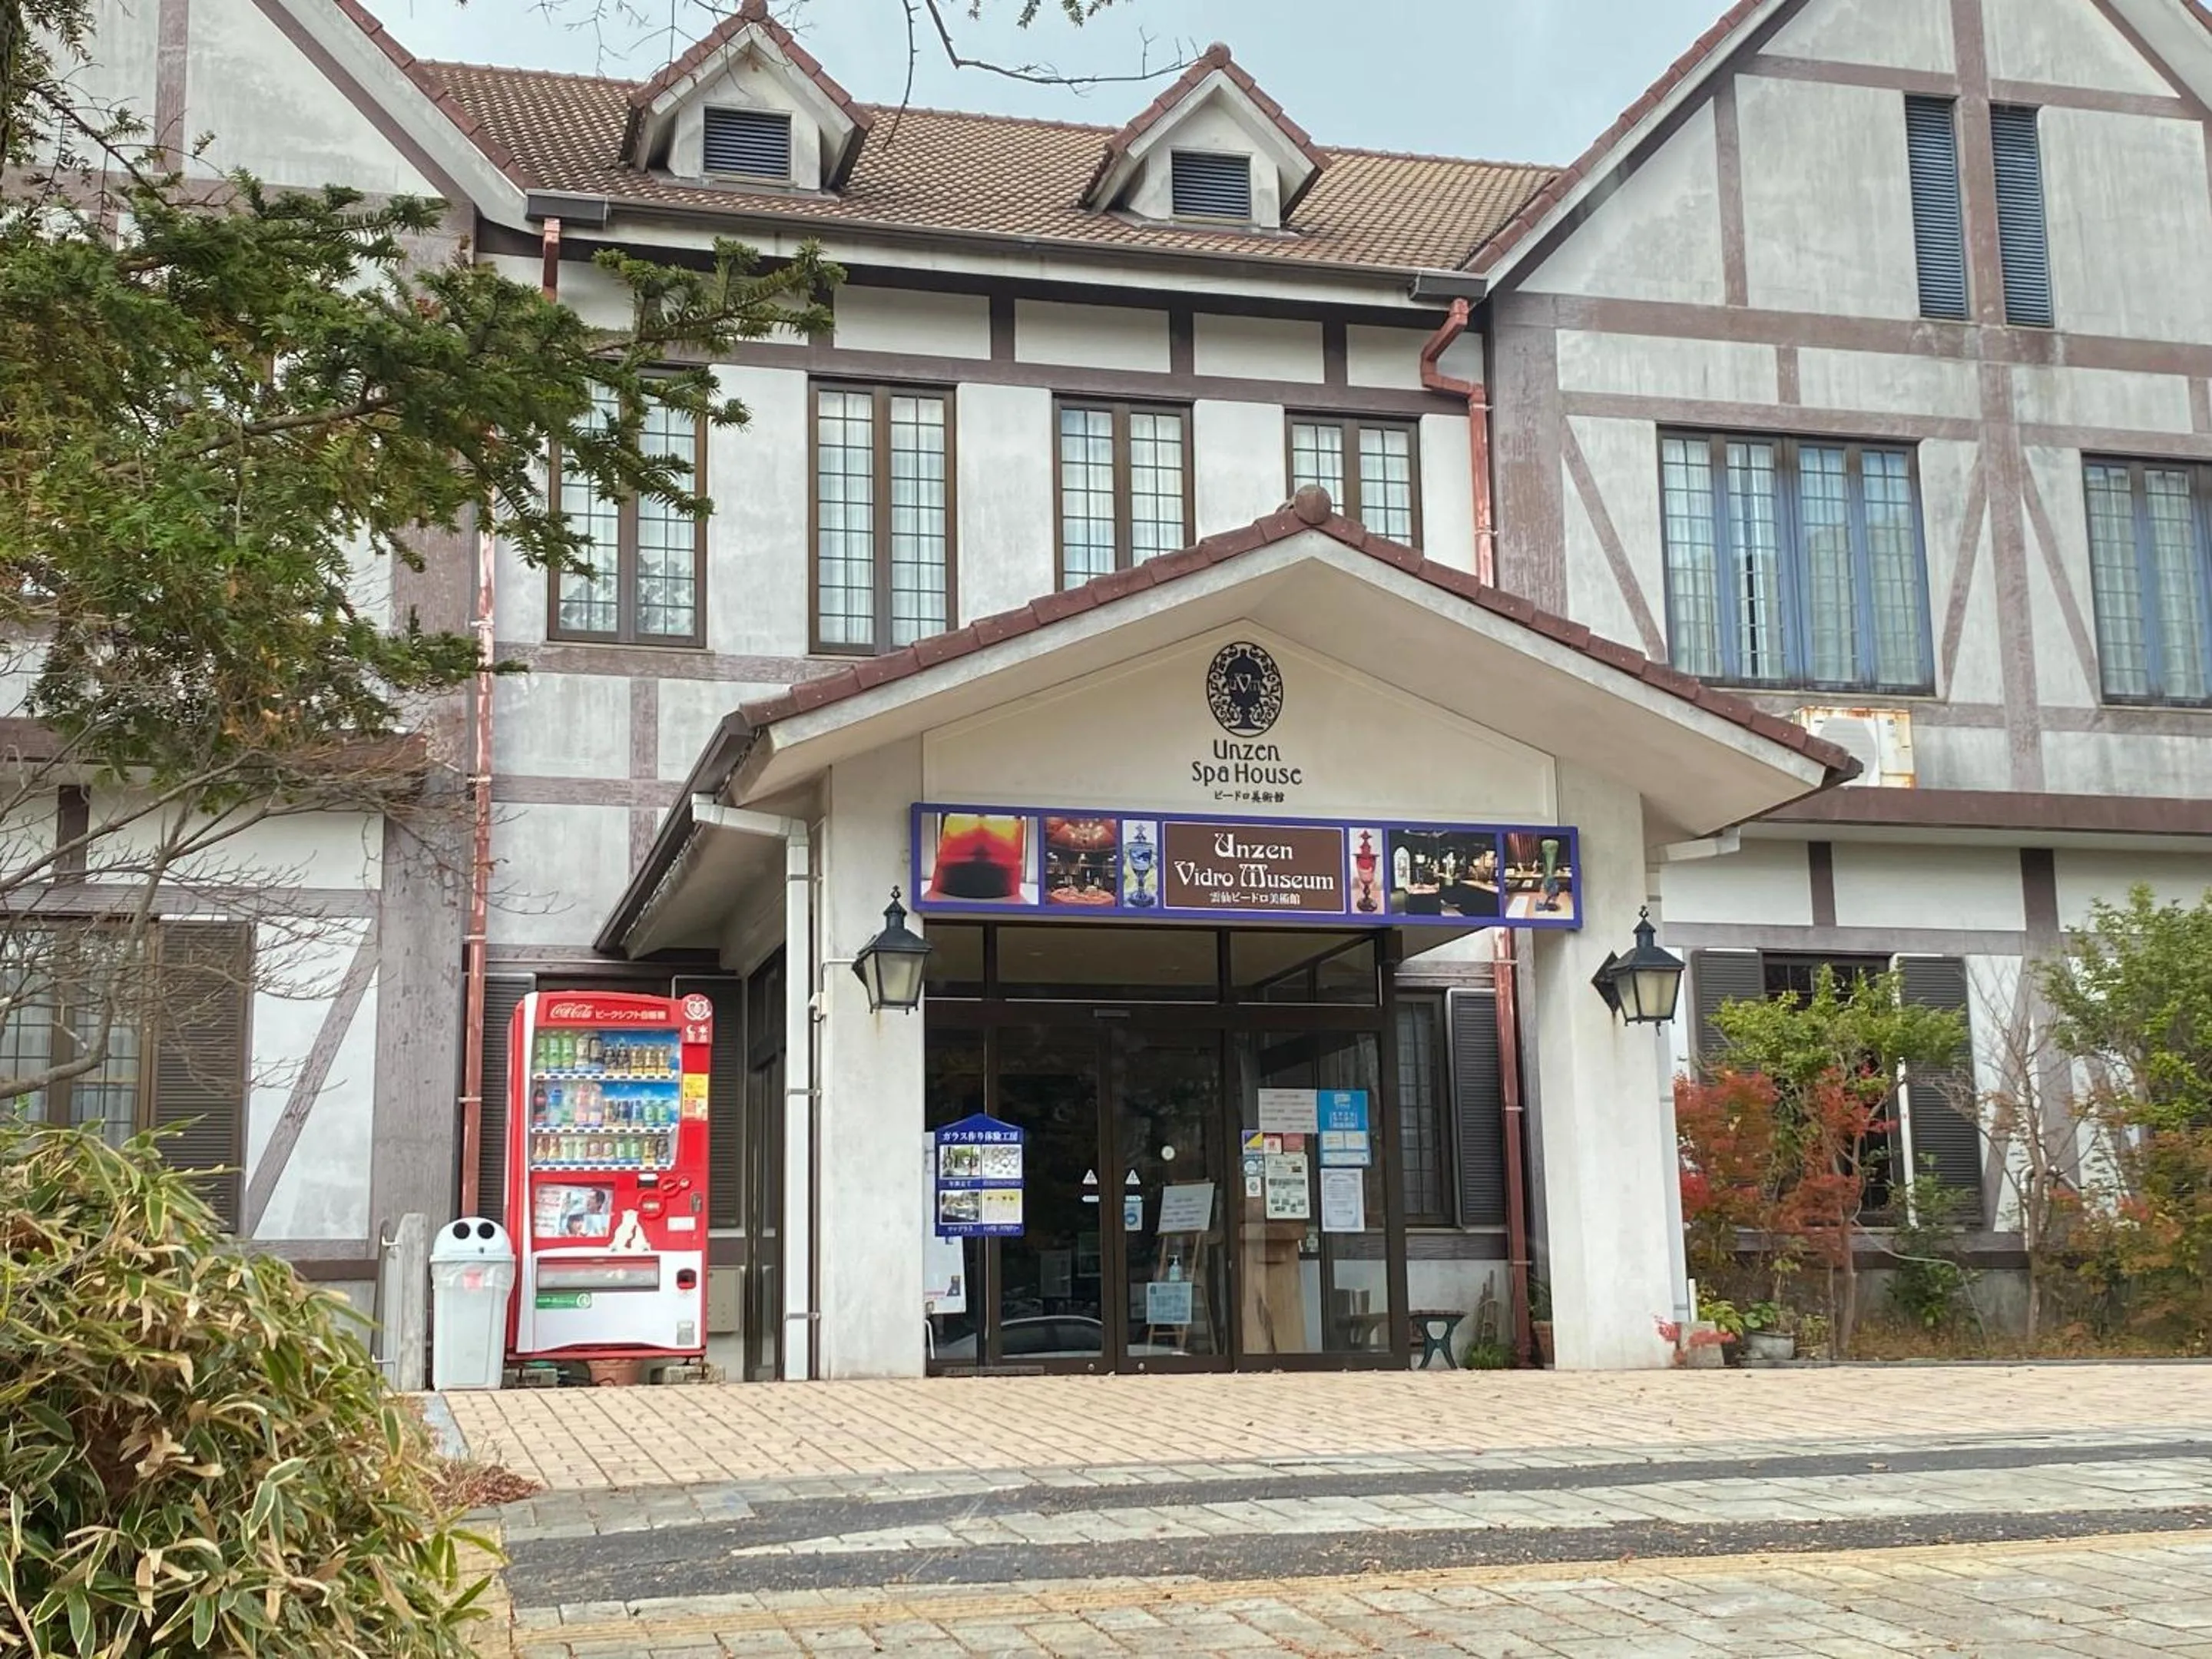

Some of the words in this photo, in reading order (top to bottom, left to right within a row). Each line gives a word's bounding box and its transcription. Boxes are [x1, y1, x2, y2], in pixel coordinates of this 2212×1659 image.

[1213, 739, 1281, 761] Unzen
[1192, 760, 1229, 786] Spa
[1234, 762, 1303, 785] House
[1214, 833, 1293, 859] Unzen
[1174, 860, 1234, 886] Vidro
[1239, 863, 1334, 890] Museum
